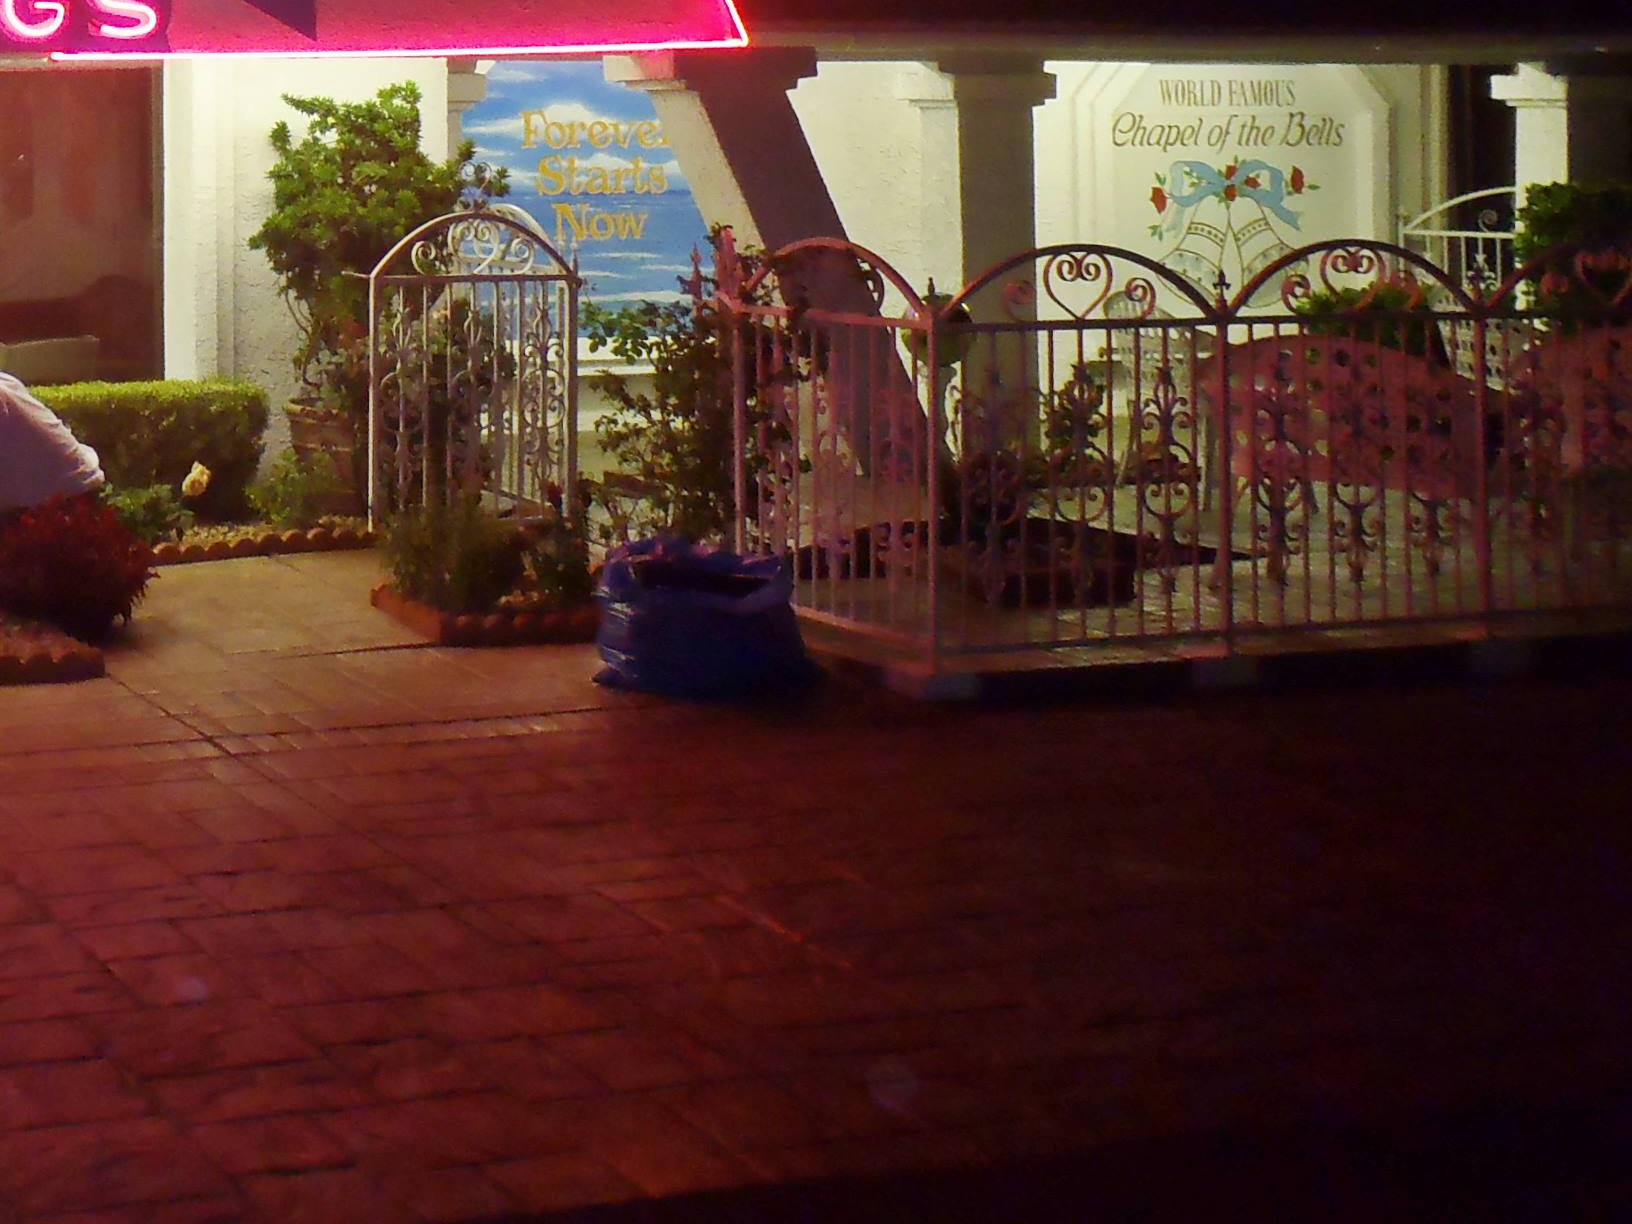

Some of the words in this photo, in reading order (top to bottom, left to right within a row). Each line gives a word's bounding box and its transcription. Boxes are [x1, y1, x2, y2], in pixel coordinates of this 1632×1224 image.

[1159, 79, 1222, 107] WORLD
[1228, 79, 1296, 107] FAMOUS
[1112, 111, 1204, 153] Chapel
[1207, 114, 1239, 154] of
[1237, 115, 1275, 147] the
[1279, 111, 1345, 147] Bells
[535, 153, 669, 196] Starts
[552, 202, 649, 242] Now
